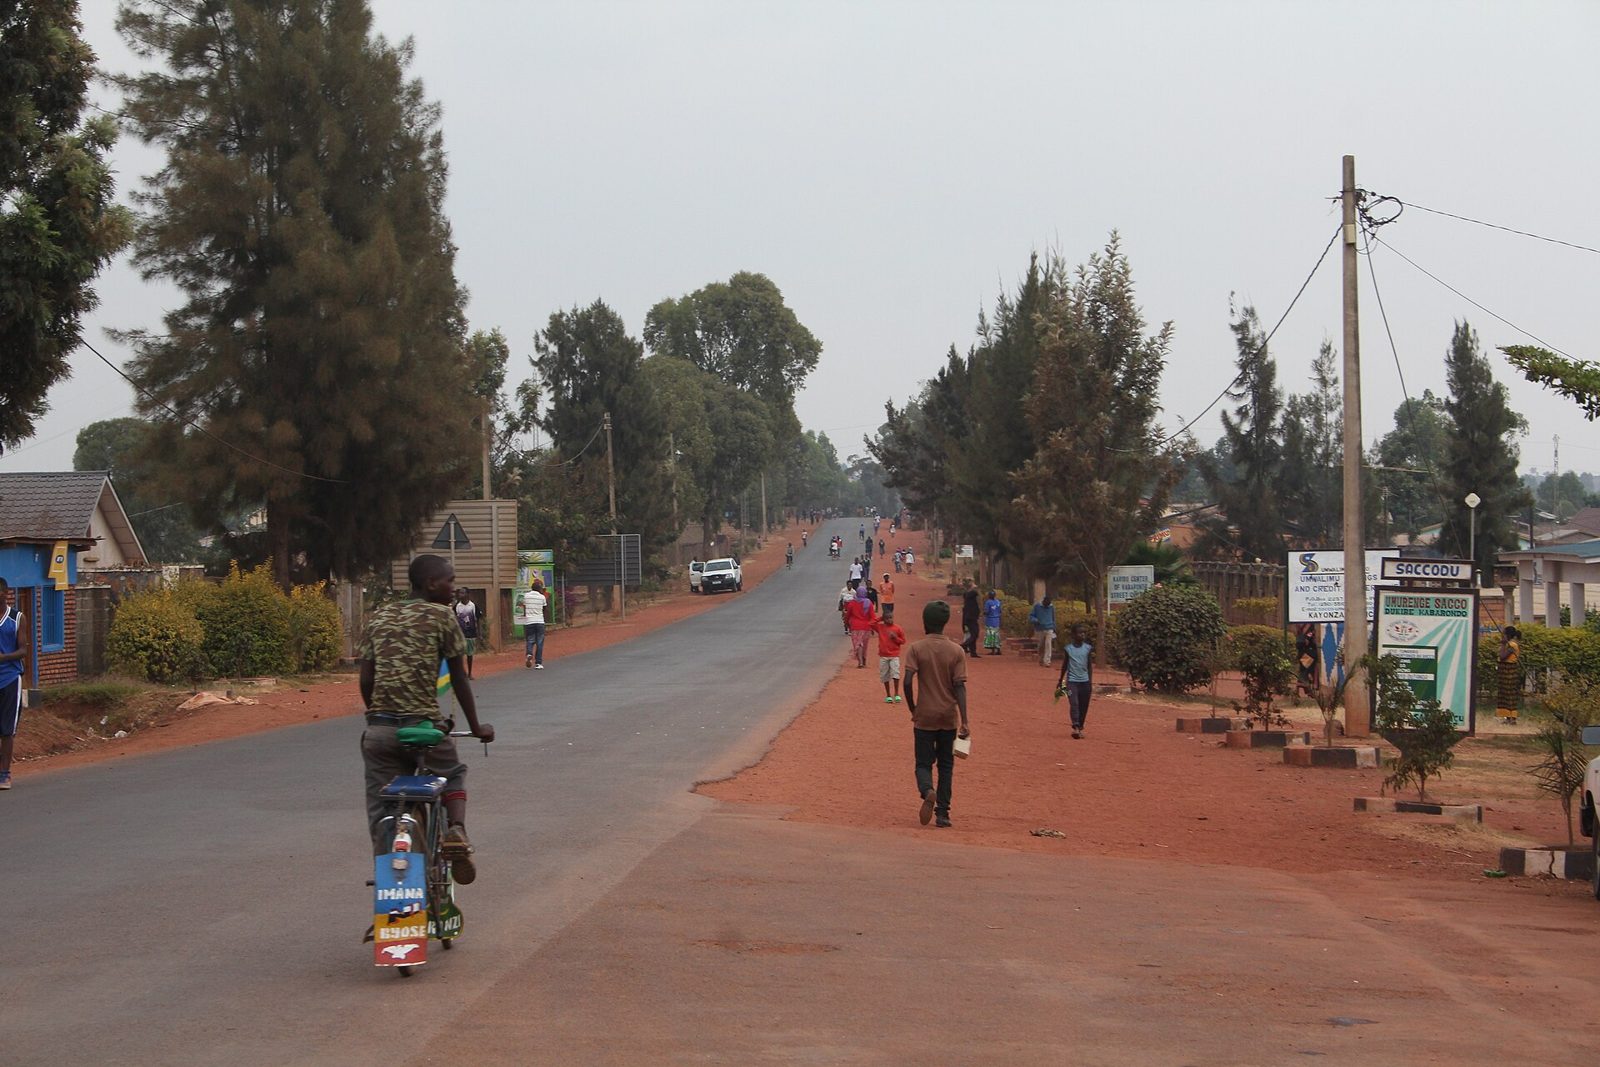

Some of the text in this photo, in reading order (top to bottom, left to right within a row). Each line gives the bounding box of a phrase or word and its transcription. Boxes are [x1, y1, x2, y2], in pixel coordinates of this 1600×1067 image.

[1396, 563, 1460, 577] SACCODU
[1300, 575, 1341, 583] UMWALIMU
[1384, 595, 1431, 608] UMURENGE
[1434, 597, 1468, 609] SACCO
[1384, 607, 1415, 616] DUKIRE
[1418, 609, 1468, 618] KABARONDO
[377, 887, 424, 901] IMANA
